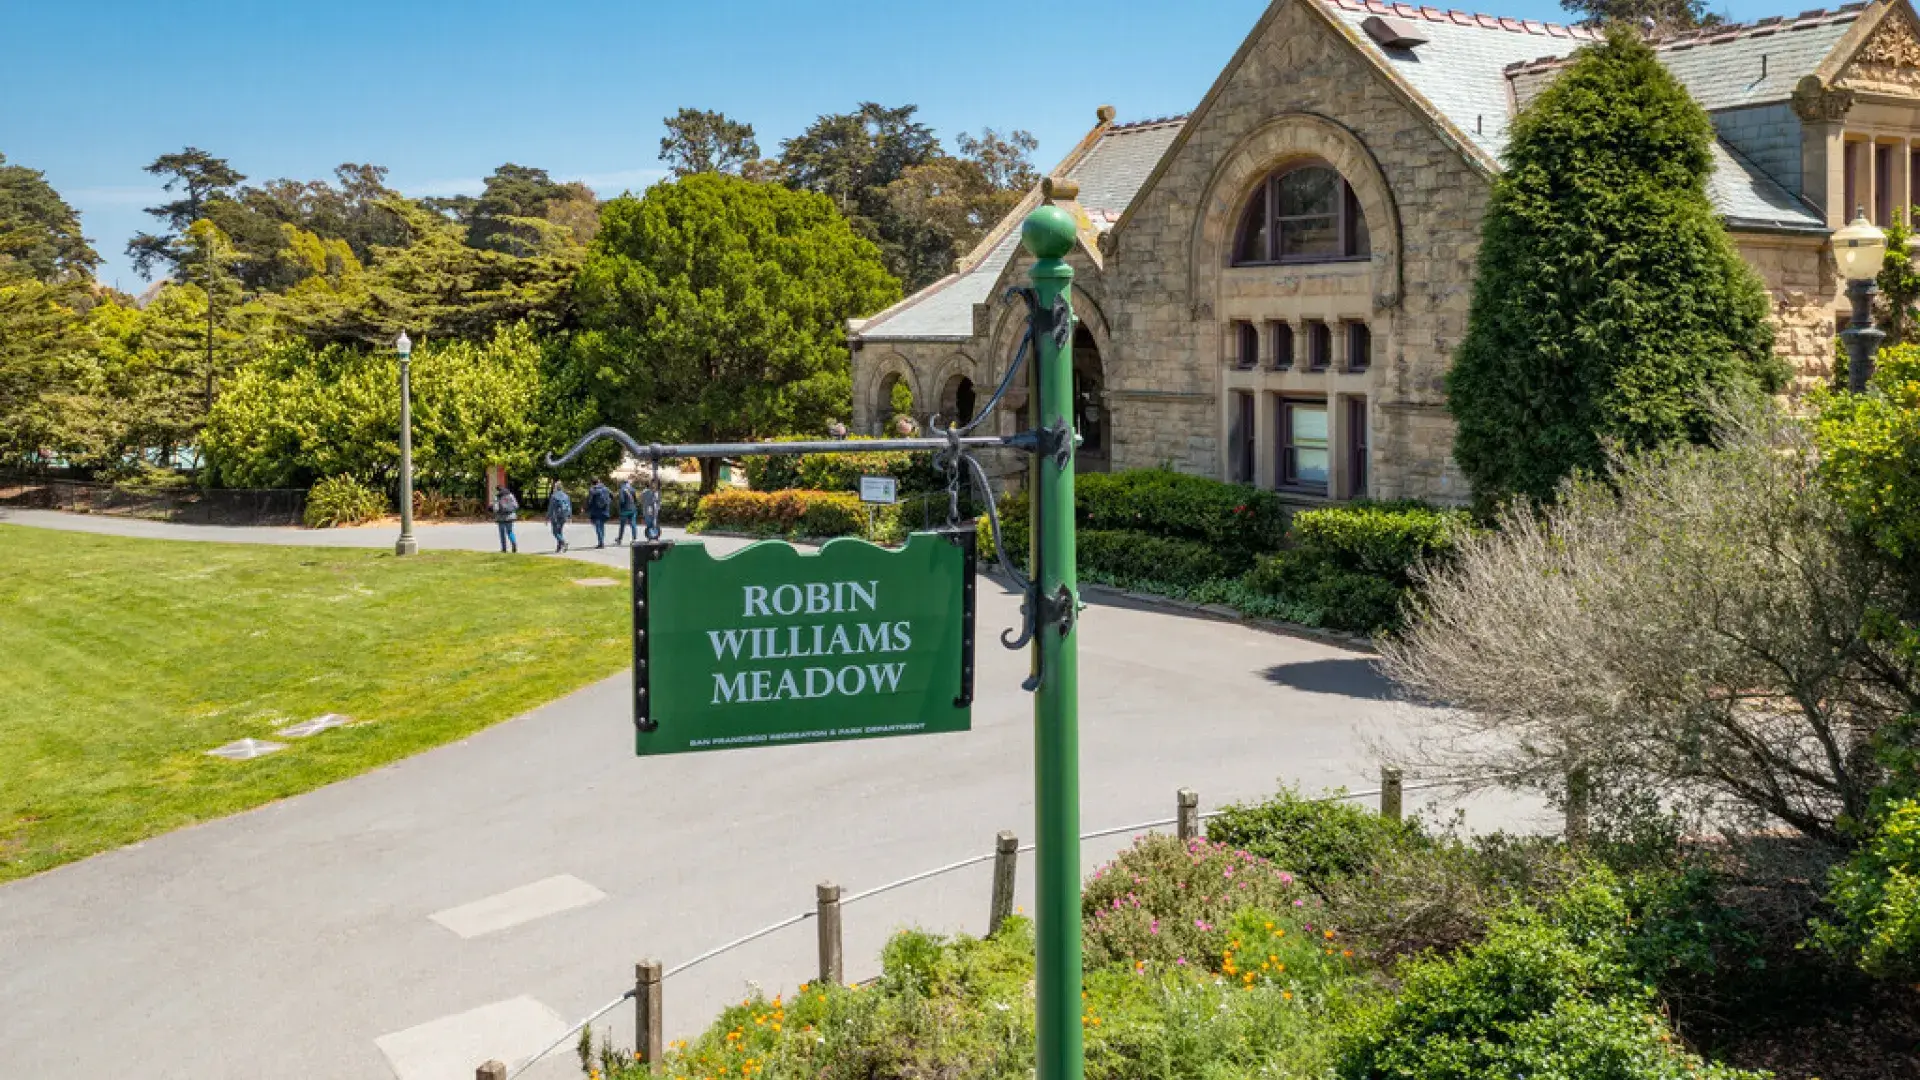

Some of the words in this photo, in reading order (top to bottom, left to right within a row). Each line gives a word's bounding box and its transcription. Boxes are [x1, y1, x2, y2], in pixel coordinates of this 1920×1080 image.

[742, 580, 878, 616] ROBIN
[706, 621, 911, 660] WILLIAMS
[711, 663, 906, 704] MEADOW
[689, 739, 710, 747] SAN
[712, 734, 768, 745] FRANCISCO
[769, 730, 828, 741] RECREATION
[838, 727, 863, 735] PARK
[865, 722, 925, 734] DEPARTMENT
